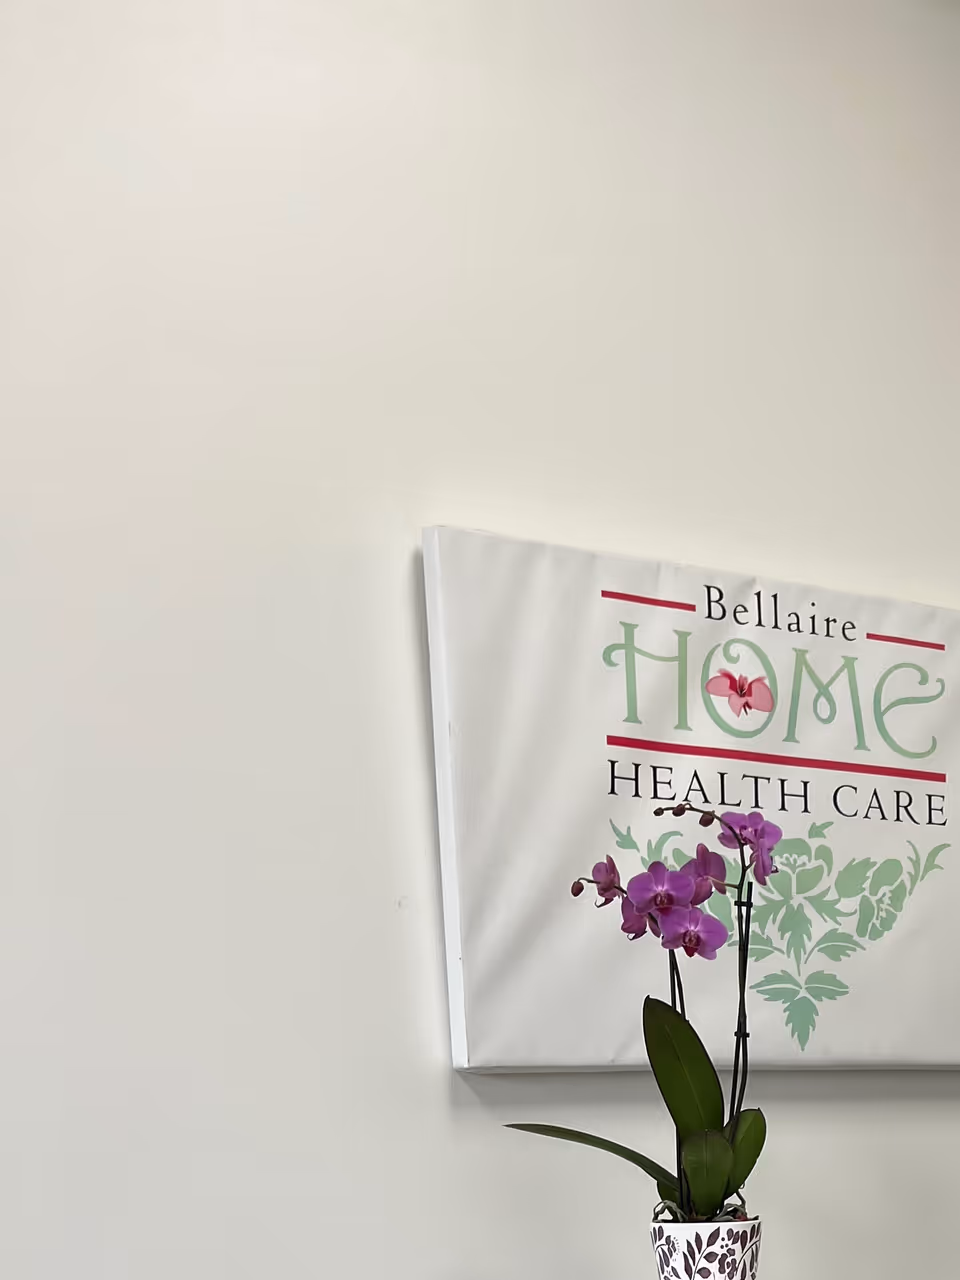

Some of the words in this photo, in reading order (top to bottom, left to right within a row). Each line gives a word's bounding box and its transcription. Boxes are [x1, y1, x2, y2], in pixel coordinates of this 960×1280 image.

[703, 584, 857, 642] Bellaire
[602, 620, 946, 760] HOME
[607, 759, 811, 815] HEALTH
[832, 784, 948, 827] CARE
